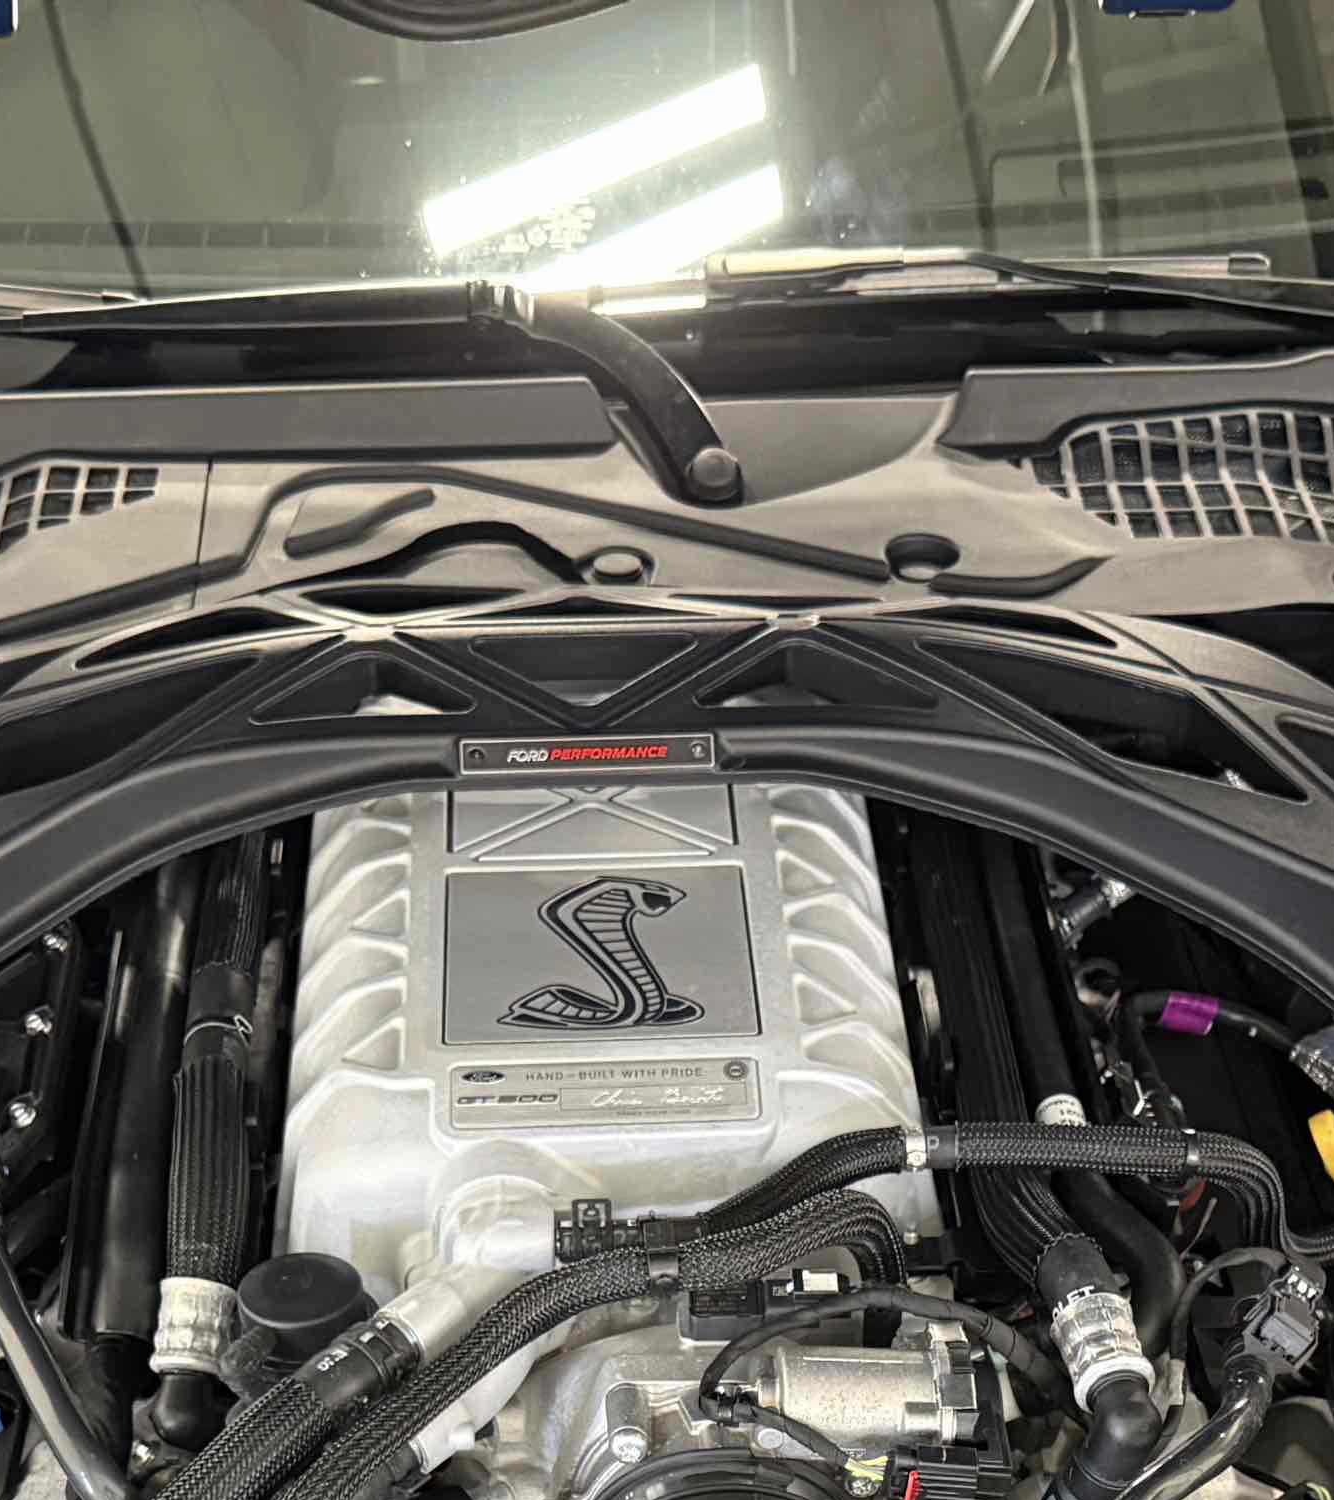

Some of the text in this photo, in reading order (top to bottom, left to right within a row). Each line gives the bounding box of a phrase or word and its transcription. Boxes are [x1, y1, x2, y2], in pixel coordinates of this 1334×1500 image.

[507, 745, 668, 763] FORD PERFORMANCE
[621, 1067, 657, 1079] WITH
[661, 1066, 704, 1078] PRIDE
